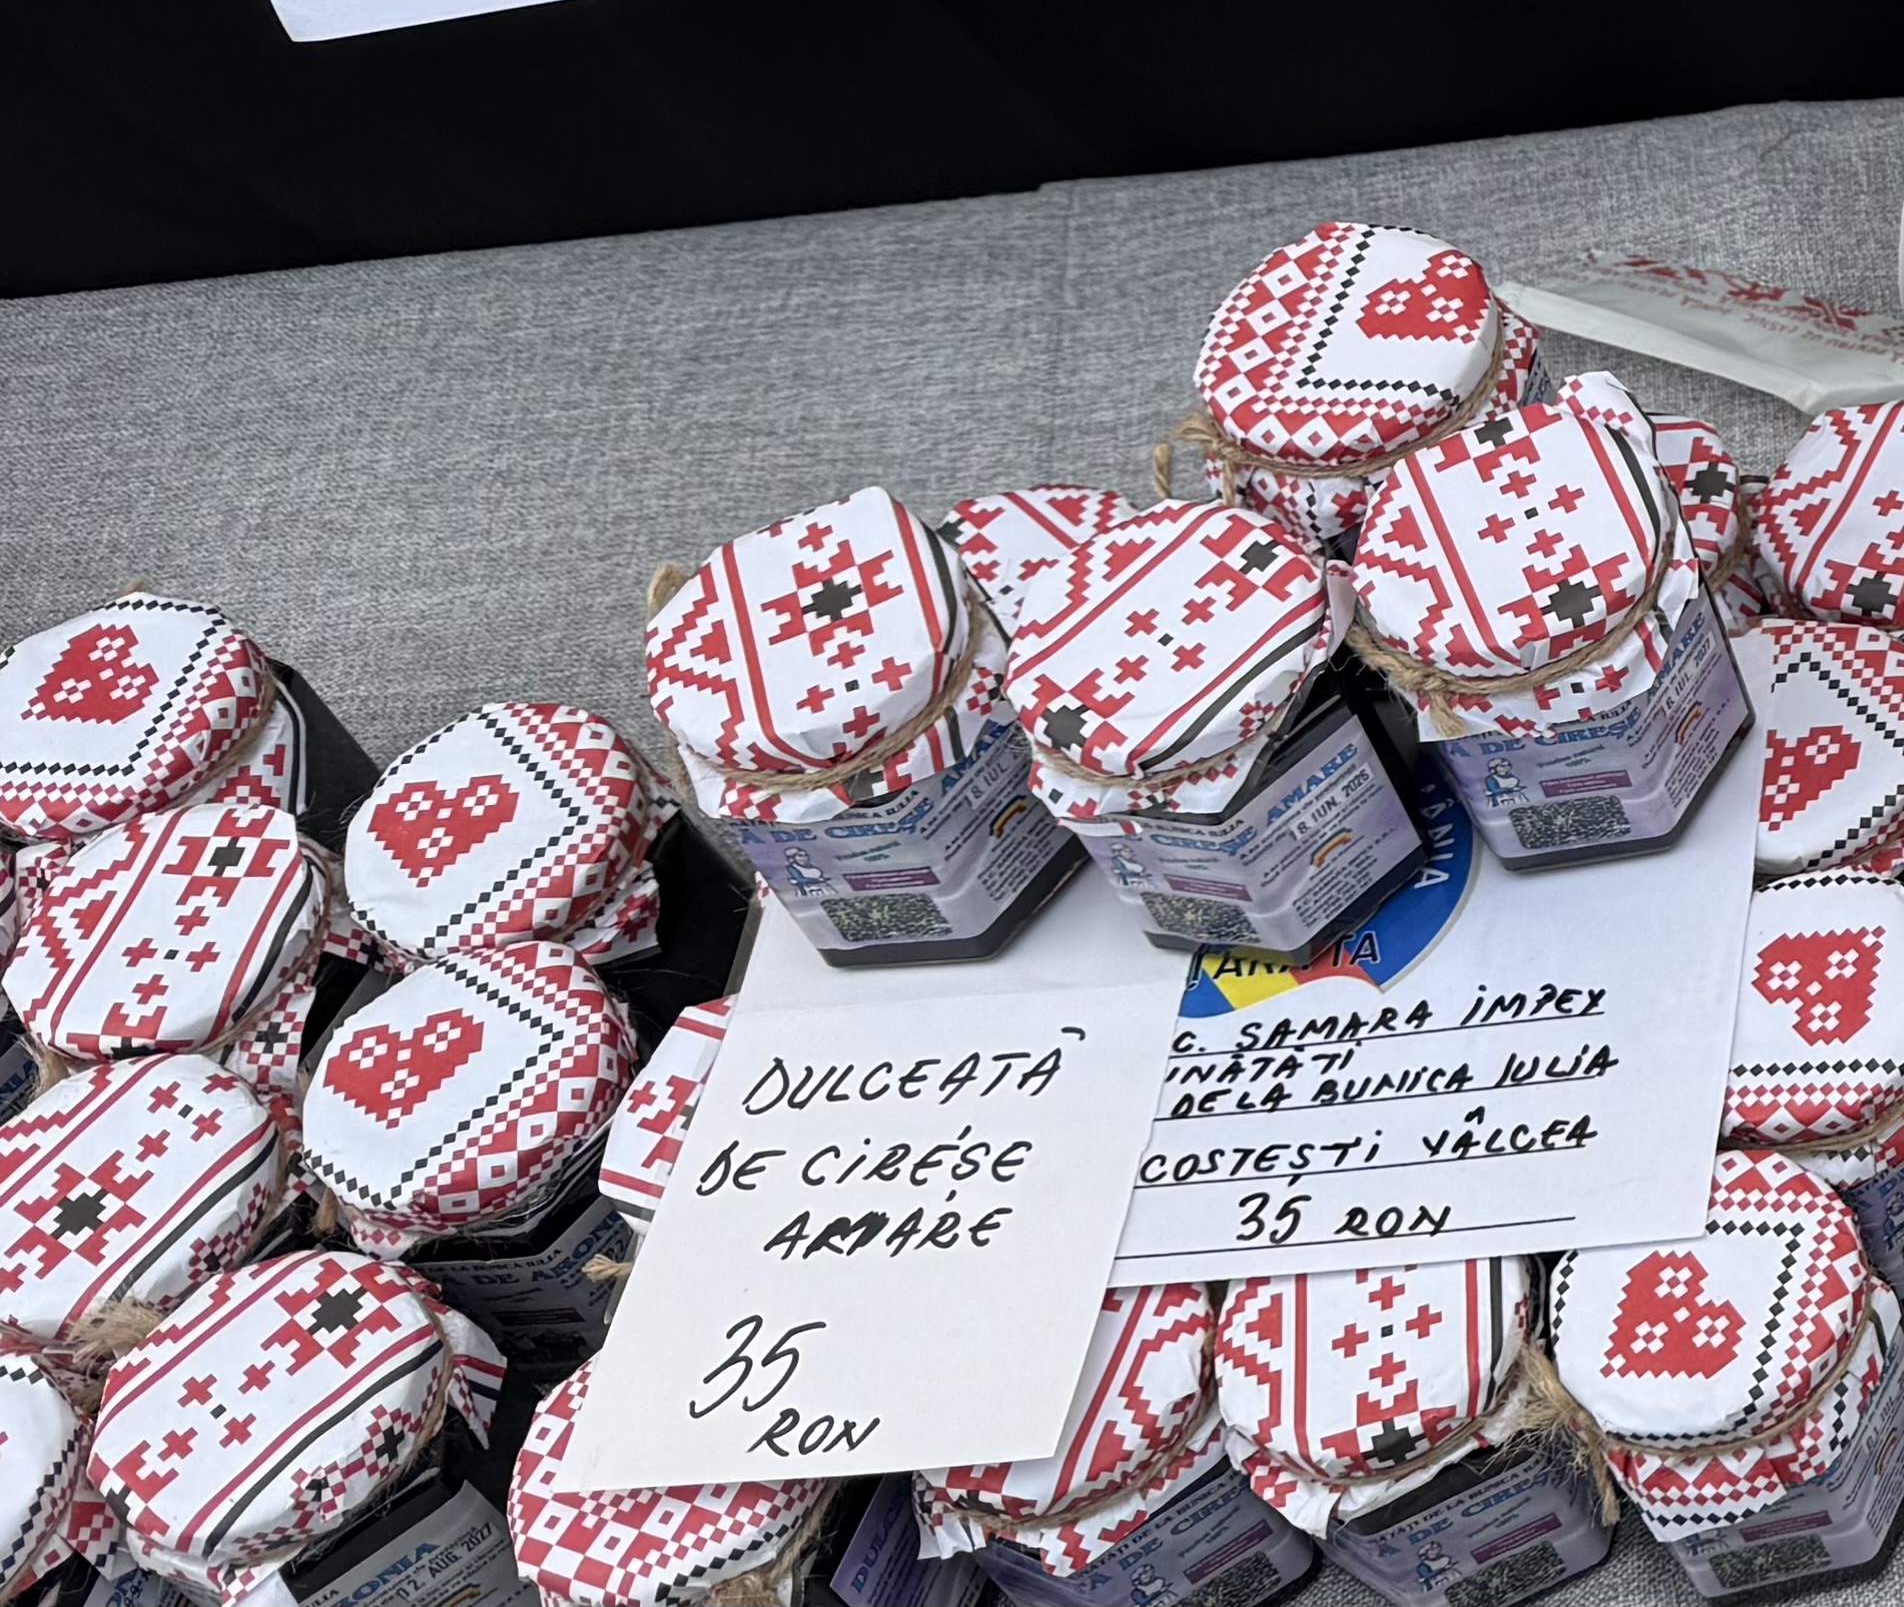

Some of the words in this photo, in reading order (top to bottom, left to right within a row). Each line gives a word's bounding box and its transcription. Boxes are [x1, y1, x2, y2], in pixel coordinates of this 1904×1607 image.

[1265, 742, 1359, 825] AMARE
[1235, 1000, 1435, 1053] SAMARA
[695, 1140, 786, 1198] DE
[1235, 1191, 1314, 1245] 35
[1334, 1202, 1453, 1238] RON
[688, 1314, 828, 1421] 35
[745, 1408, 882, 1458] RON
